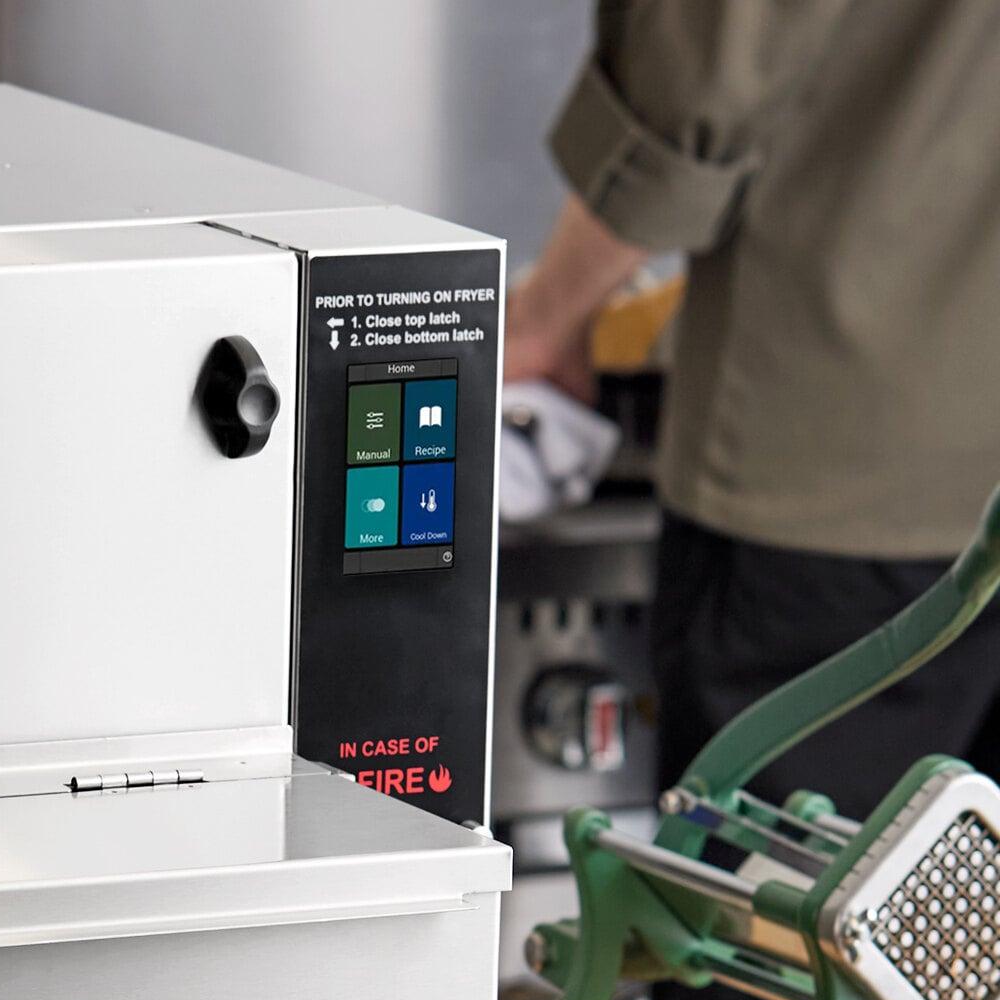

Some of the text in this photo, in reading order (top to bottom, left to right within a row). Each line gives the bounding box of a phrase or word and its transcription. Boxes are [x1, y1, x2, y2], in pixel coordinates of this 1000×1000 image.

[315, 288, 495, 309] PRIOR TO TURNING ON FRYER
[351, 311, 460, 329] 1. Close top latch
[350, 328, 484, 347] 2. Close bottom latch
[387, 363, 415, 374] Home
[356, 449, 391, 461] Manual
[415, 445, 447, 457] Recipe
[359, 533, 384, 544] More
[410, 531, 447, 541] Cool Down
[340, 736, 439, 758] IN CASE OF
[358, 767, 425, 796] FIRE
